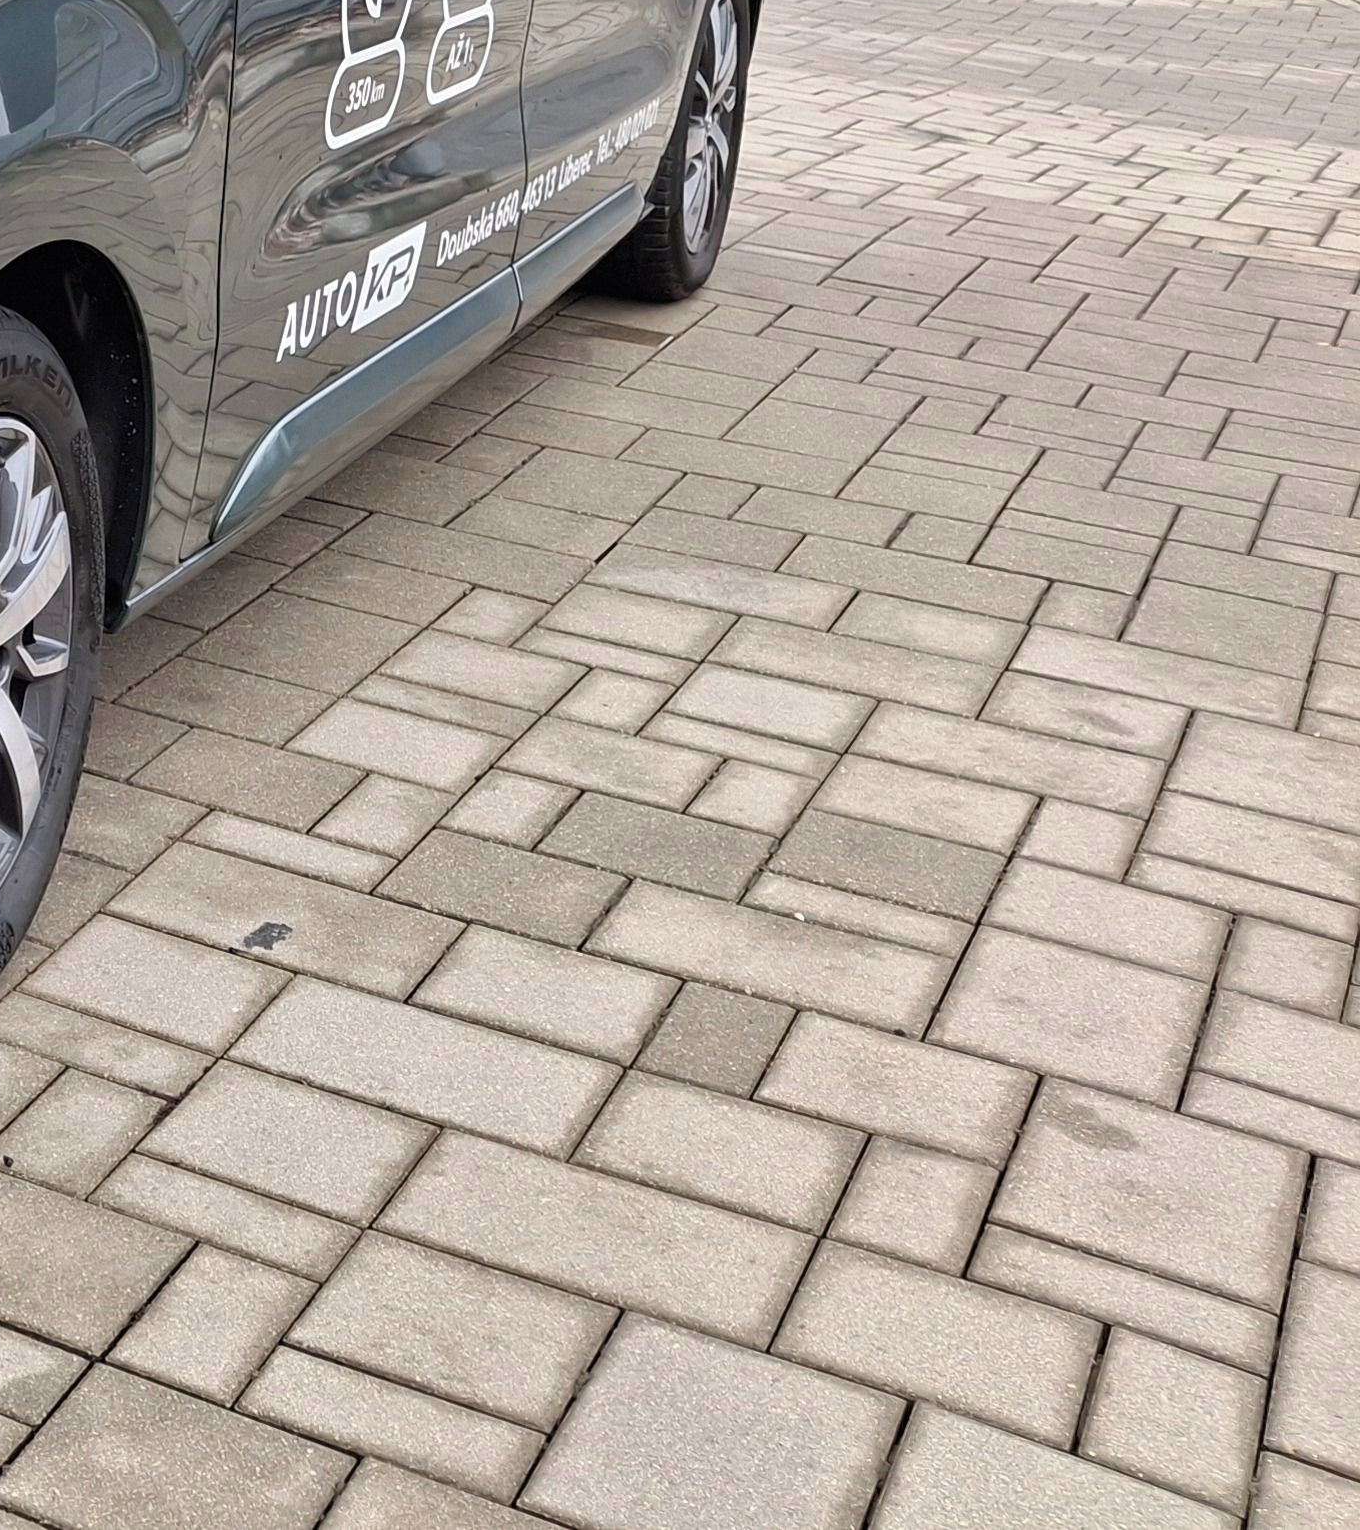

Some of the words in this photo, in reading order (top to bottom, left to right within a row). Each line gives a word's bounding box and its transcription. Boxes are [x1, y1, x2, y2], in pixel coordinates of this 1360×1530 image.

[445, 32, 465, 73] AŽ
[345, 76, 371, 113] 350
[371, 82, 385, 105] km
[276, 270, 358, 363] AUTO
[436, 200, 496, 268] Doubská
[495, 189, 522, 233] 660,
[521, 175, 544, 215] 463
[544, 165, 557, 201] 13
[557, 149, 593, 193] Liberec
